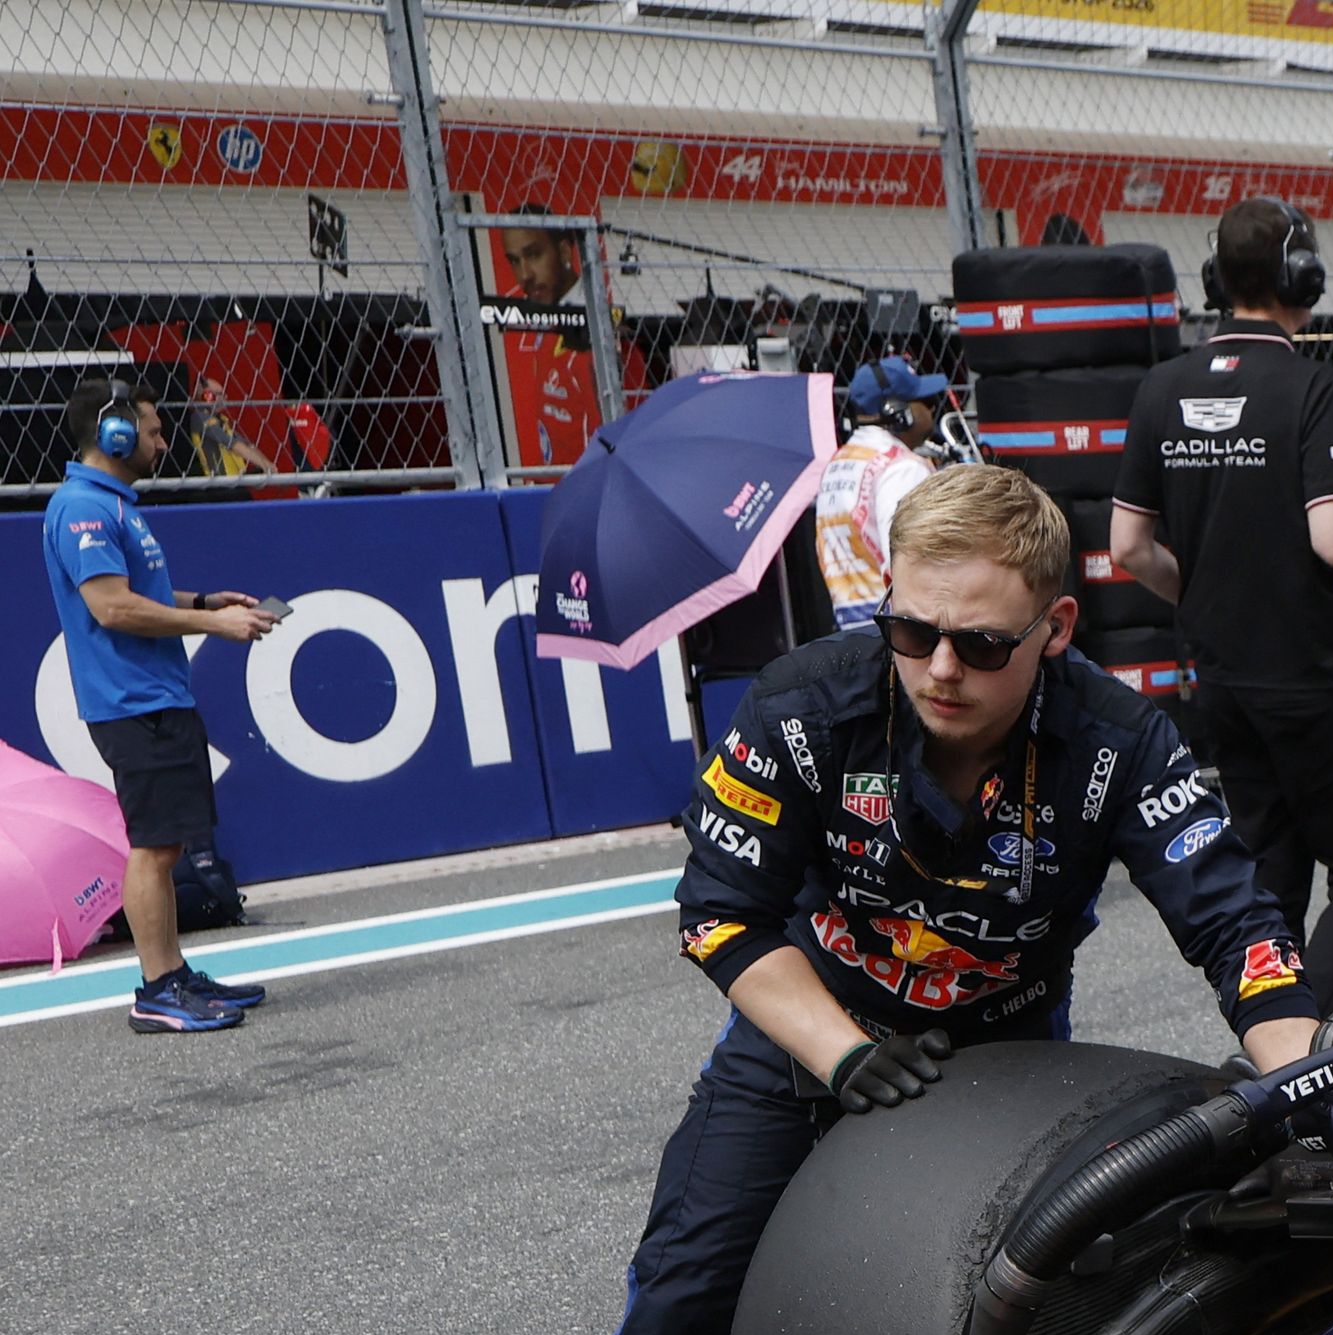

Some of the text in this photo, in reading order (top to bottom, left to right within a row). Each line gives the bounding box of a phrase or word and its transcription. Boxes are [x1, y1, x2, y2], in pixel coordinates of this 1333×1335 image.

[721, 153, 762, 183] 44
[777, 175, 908, 195] HAMILTON
[526, 313, 586, 326] LOGISTICS
[1161, 438, 1266, 455] CADILLAC
[1164, 458, 1219, 468] FORMULA
[724, 727, 779, 782] Mobil
[780, 717, 822, 794] sparco
[712, 763, 774, 818] PIRELLI
[1081, 746, 1119, 824] sparco
[845, 796, 890, 821] HEU
[700, 802, 762, 867] VISA
[810, 911, 908, 996] Red
[981, 979, 1048, 1023] C. HELBO
[1296, 1135, 1327, 1151] YET
